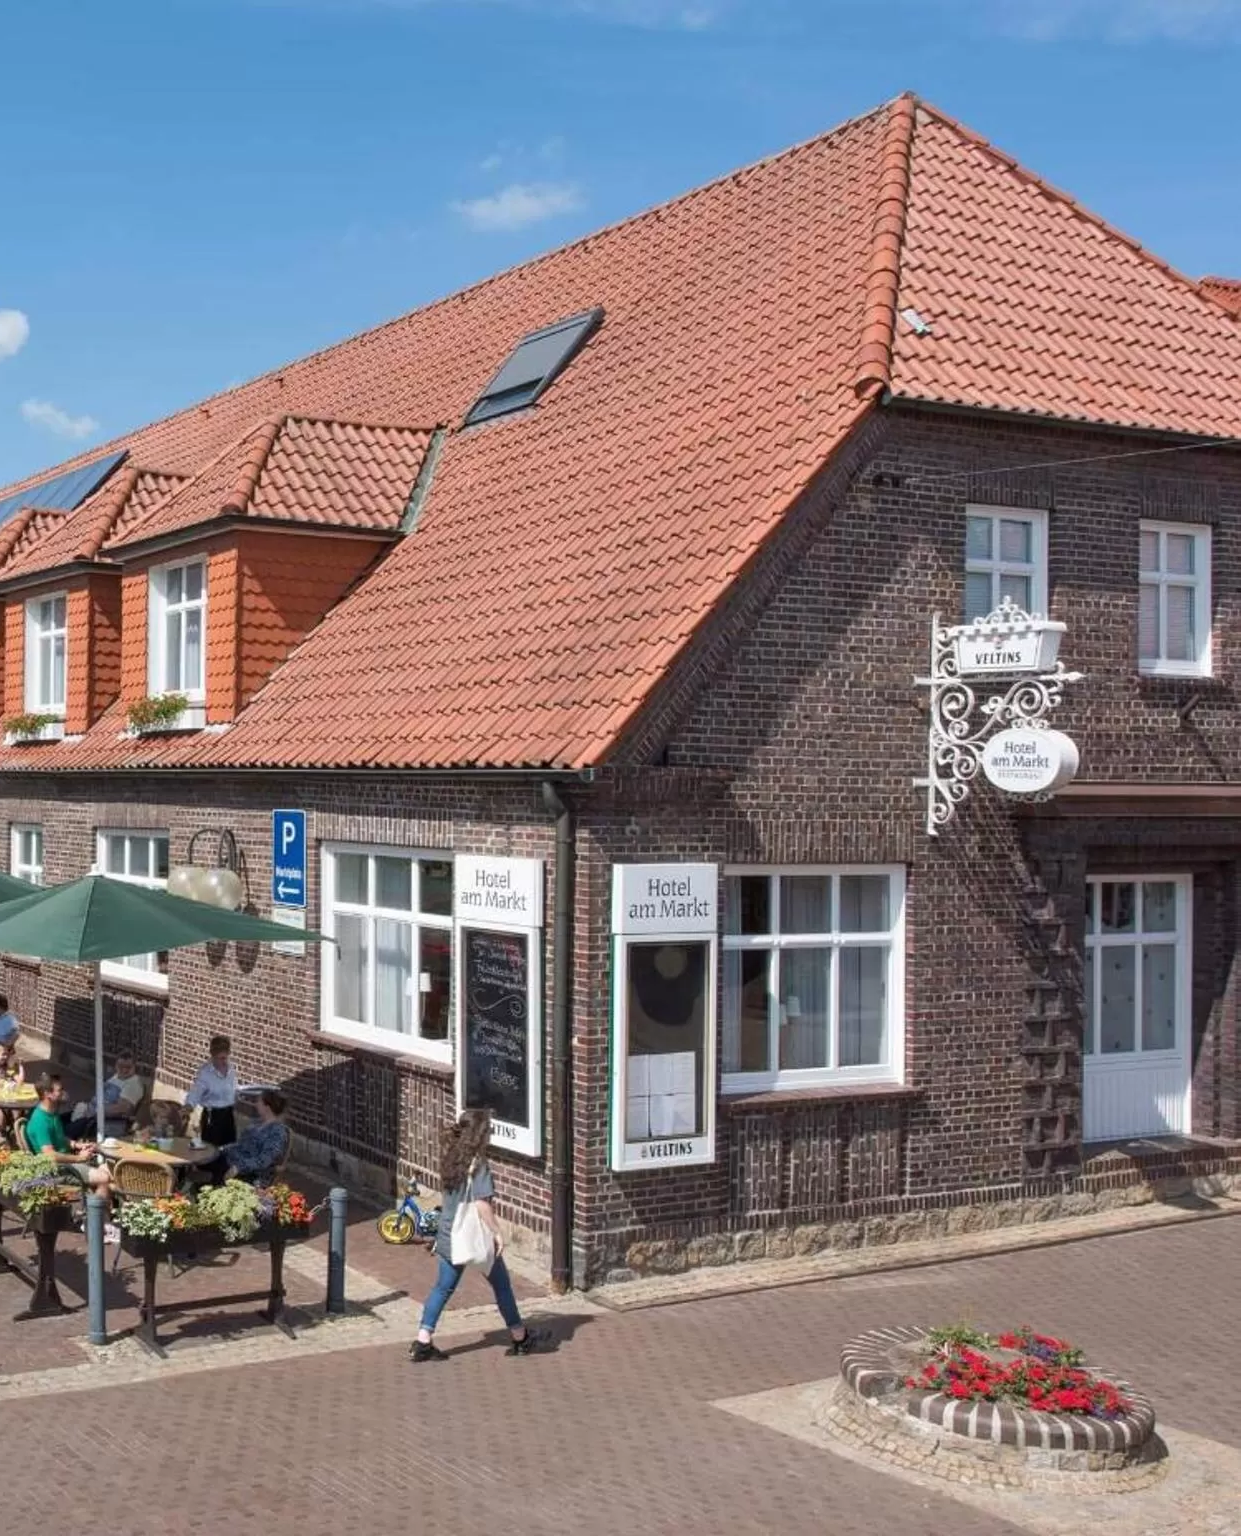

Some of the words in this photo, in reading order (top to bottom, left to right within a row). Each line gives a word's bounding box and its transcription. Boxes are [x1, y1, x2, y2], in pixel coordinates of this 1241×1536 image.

[975, 652, 1022, 665] VELTINS
[1004, 741, 1037, 755] Hotel
[991, 756, 1010, 767] am
[1012, 754, 1049, 768] Markt
[282, 821, 296, 855] P
[475, 869, 511, 889] Hotel
[648, 877, 691, 897] Hotel
[460, 892, 482, 906] am
[484, 891, 527, 911] Markt
[629, 904, 656, 919] am
[659, 898, 711, 919] Markt
[649, 1141, 693, 1158] VELTINS
